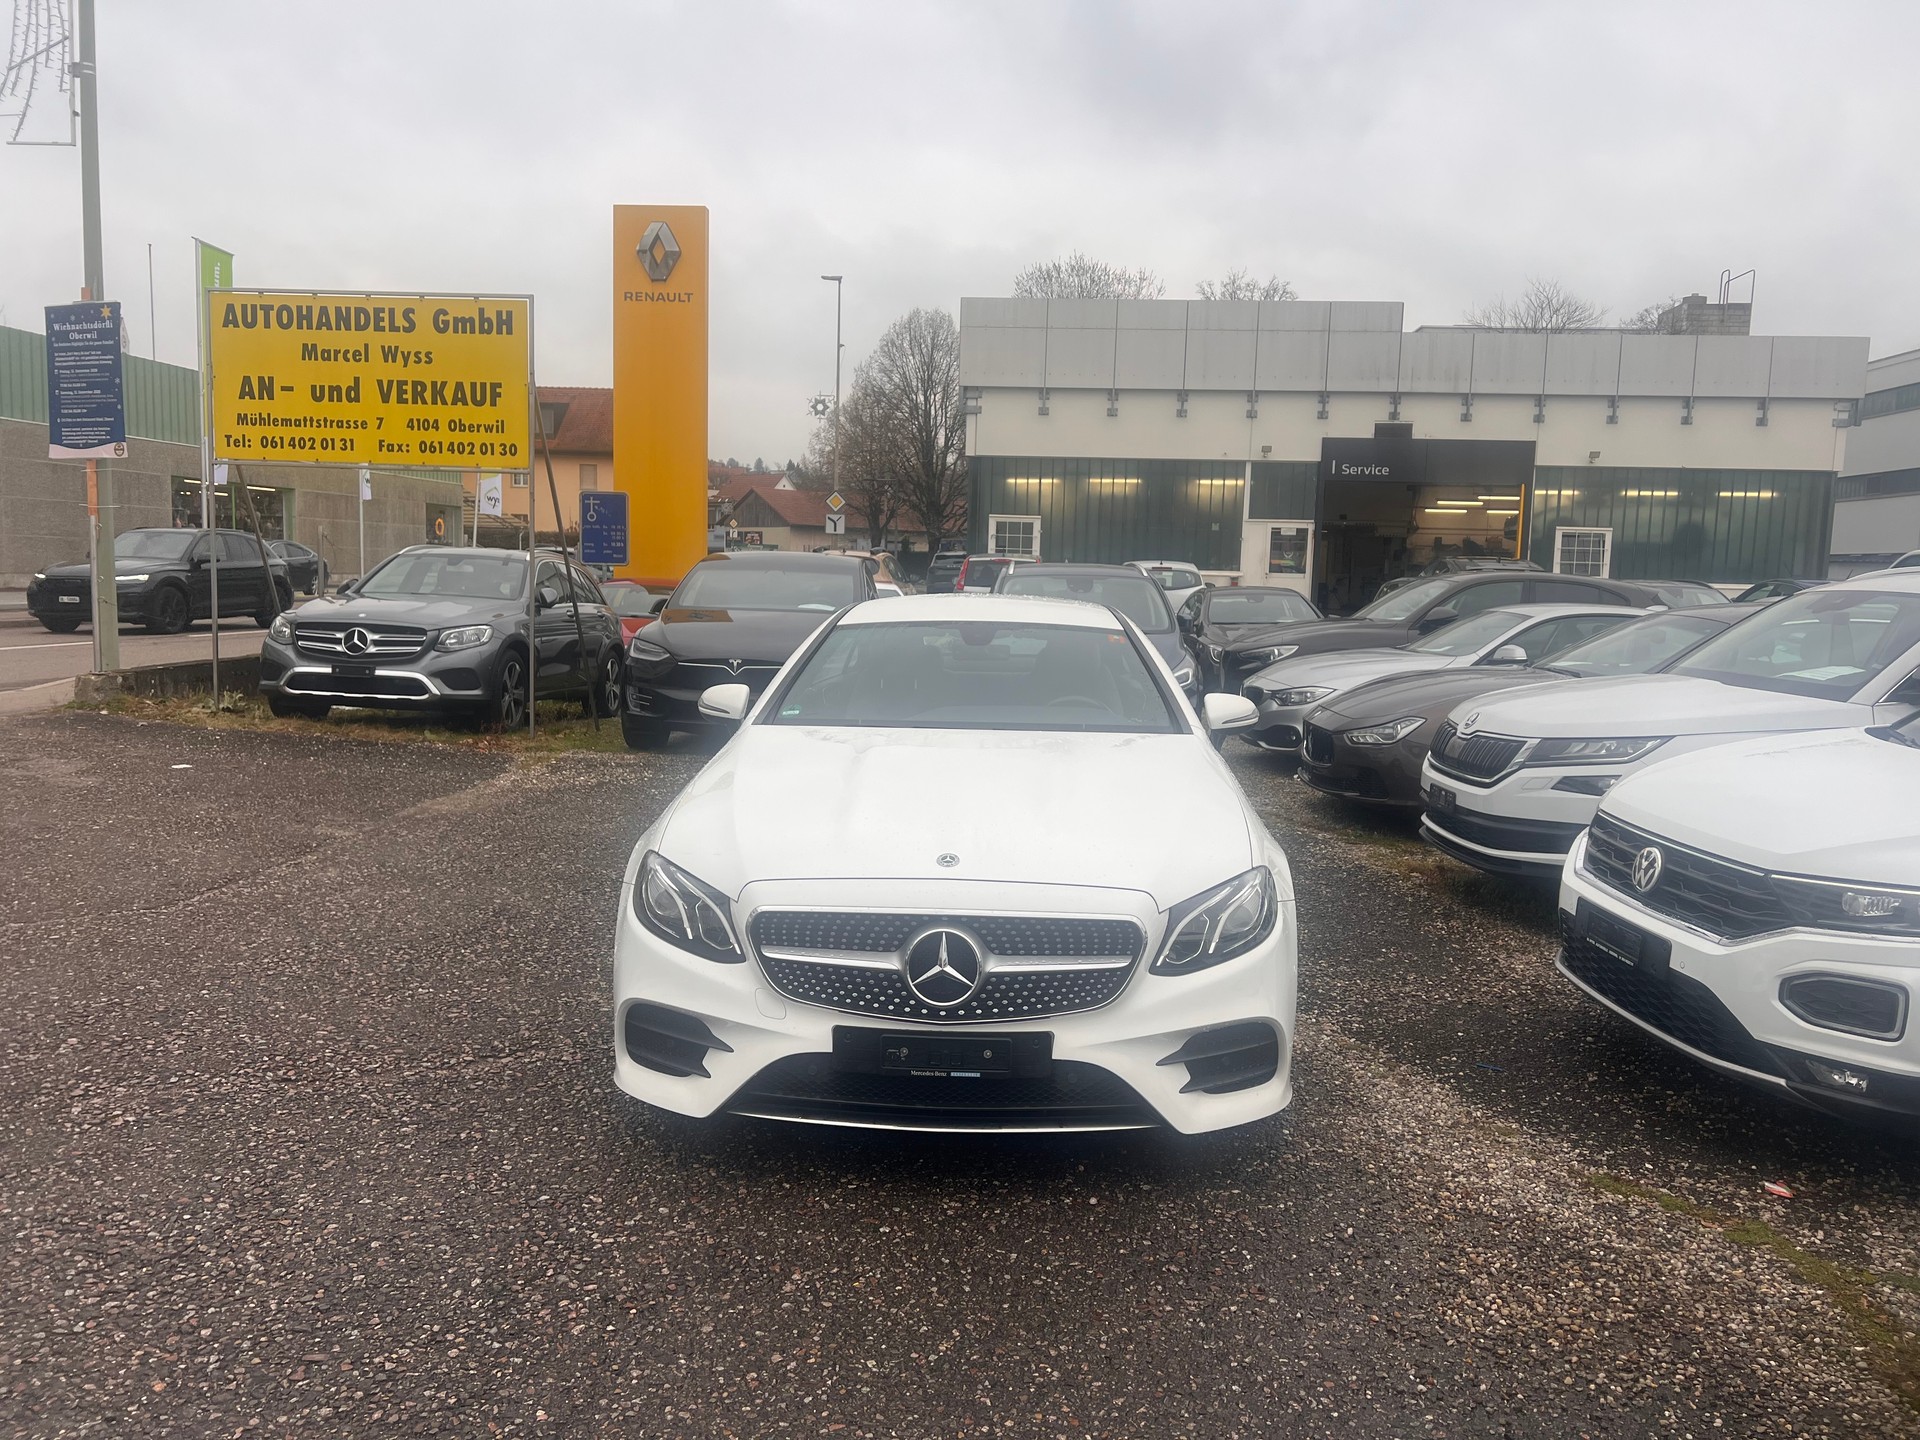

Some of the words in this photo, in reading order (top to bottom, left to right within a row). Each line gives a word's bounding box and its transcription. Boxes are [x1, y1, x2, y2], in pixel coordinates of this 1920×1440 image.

[624, 291, 694, 303] RENAULT
[222, 303, 417, 334] AUTOHANDELS
[432, 307, 514, 336] GmbH
[69, 331, 97, 340] Oberwil
[301, 343, 370, 363] Marcel
[380, 345, 434, 368] Wyss
[238, 375, 295, 401] AN-
[310, 376, 361, 404] und
[376, 379, 503, 407] VERKAUF
[236, 412, 369, 430] Mühlemattstrasse
[375, 417, 385, 430] 7
[406, 418, 440, 432] 4104
[447, 418, 506, 434] Oberwil
[224, 434, 252, 449] Tel:
[377, 439, 411, 453] Fax:
[1341, 463, 1390, 476] Service
